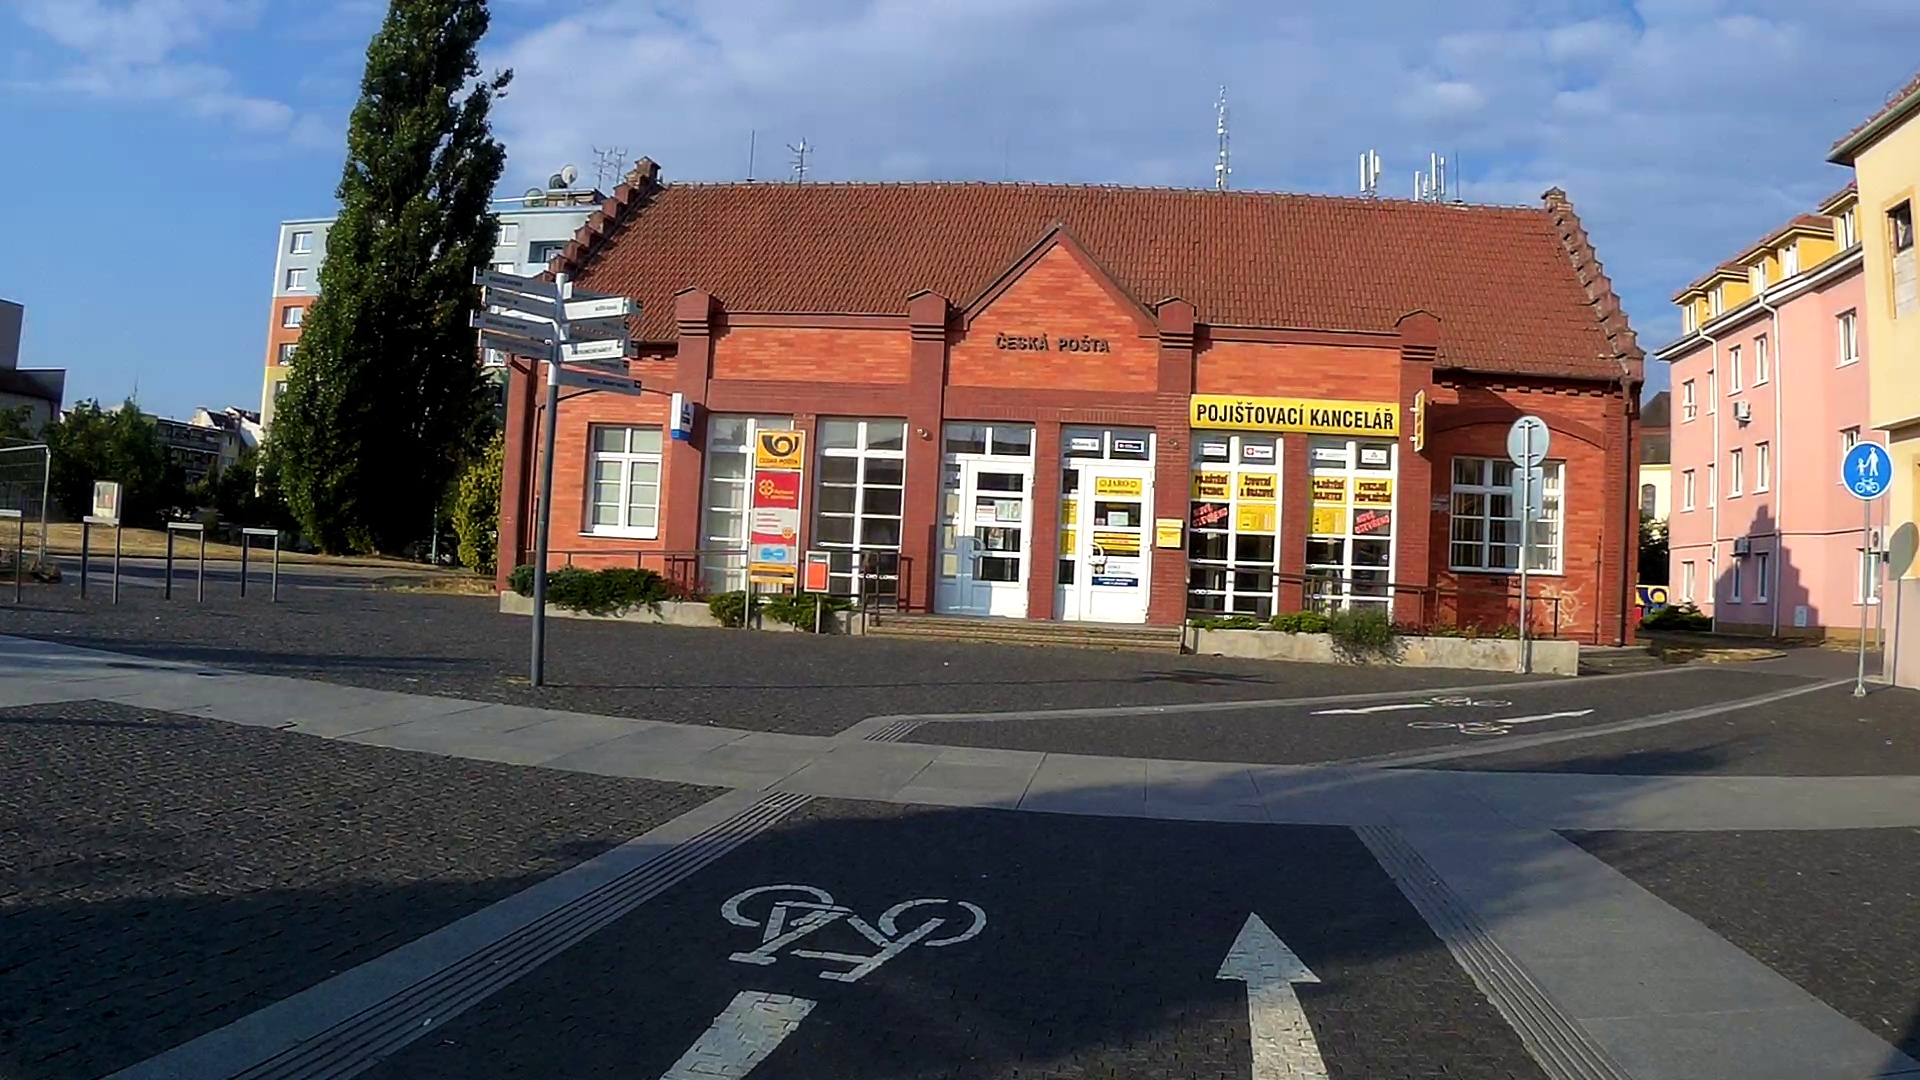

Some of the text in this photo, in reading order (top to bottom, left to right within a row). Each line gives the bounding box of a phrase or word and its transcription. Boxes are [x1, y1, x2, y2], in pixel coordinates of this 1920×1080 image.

[996, 332, 1110, 353] ČESKÁ POŠTA
[1196, 401, 1394, 430] POJIŠŤOVACÍ KANCELÁŘ
